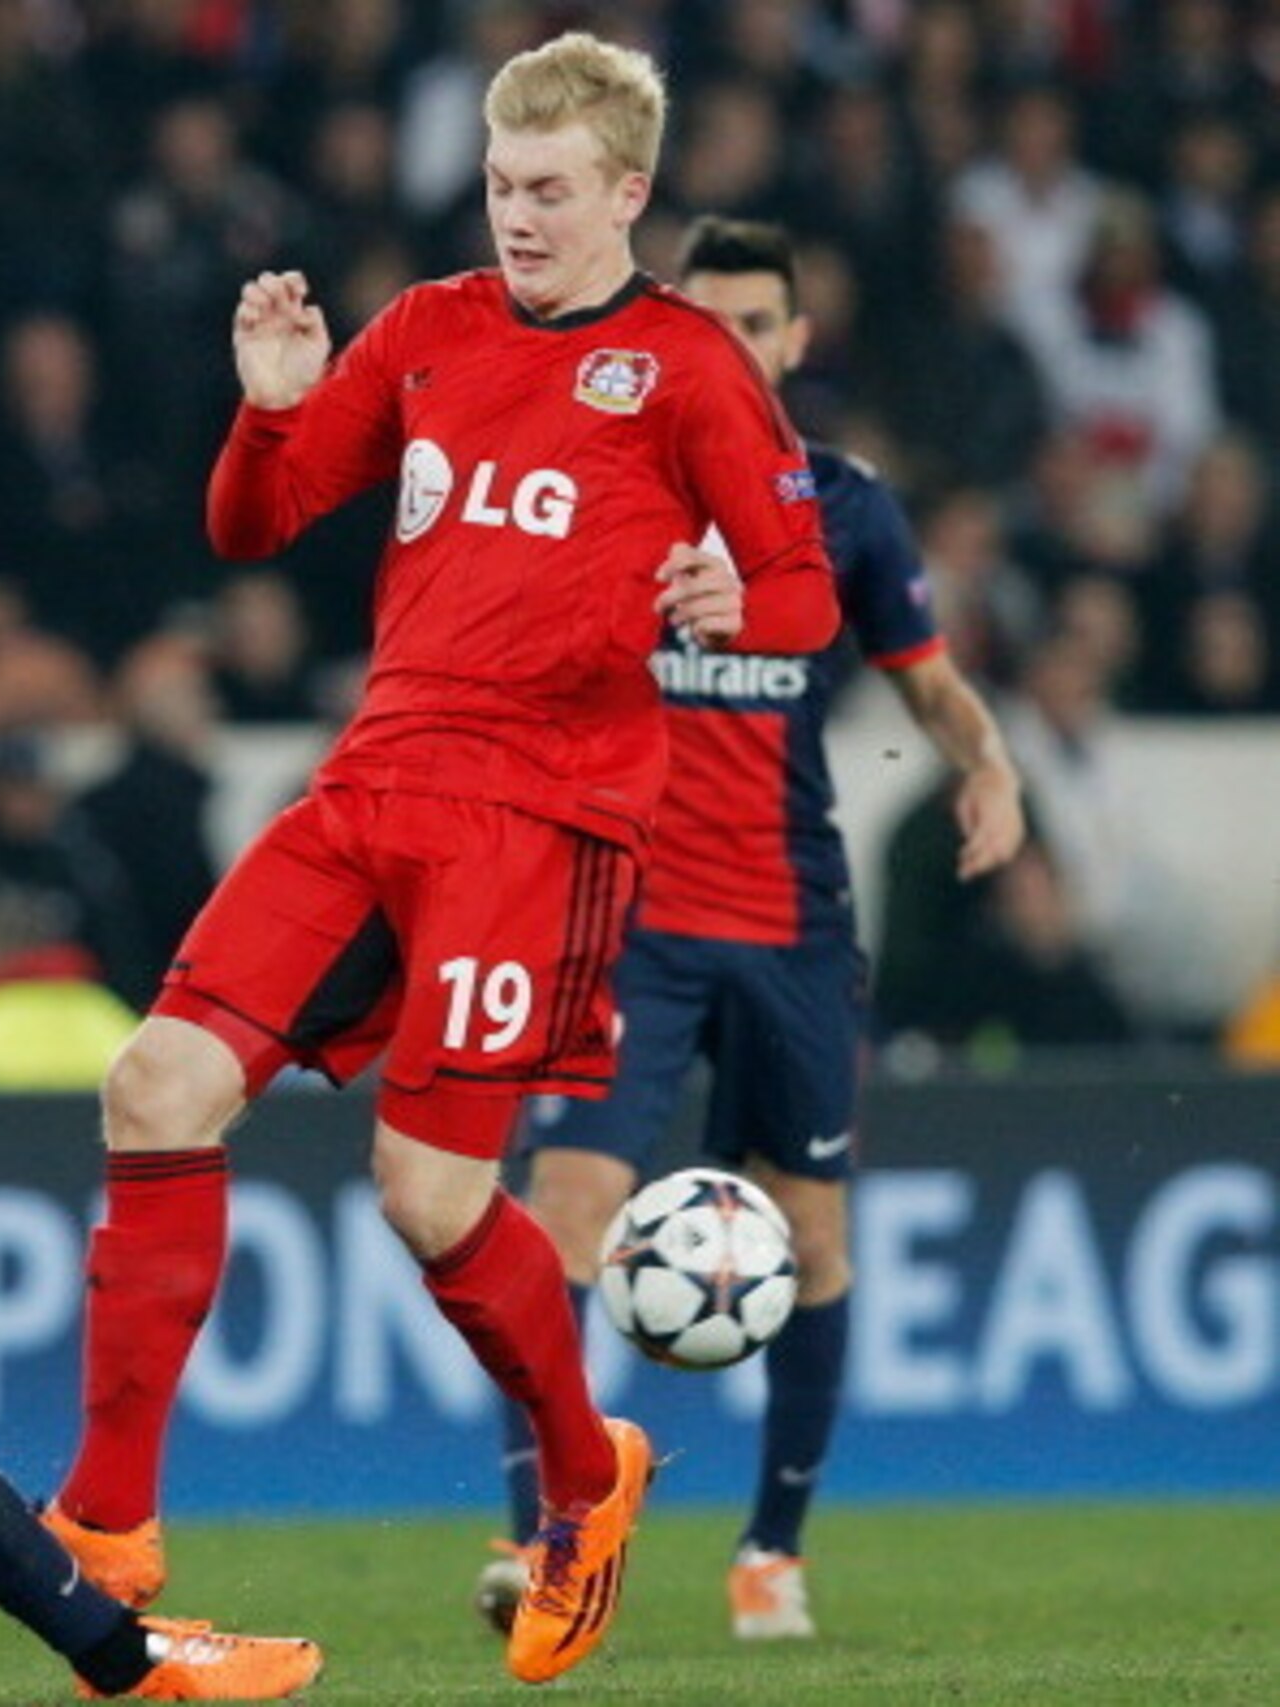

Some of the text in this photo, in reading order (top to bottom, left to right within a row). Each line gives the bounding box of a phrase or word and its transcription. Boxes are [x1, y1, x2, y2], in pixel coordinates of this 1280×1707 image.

[460, 460, 580, 540] LG
[646, 641, 811, 699] mirates
[438, 956, 532, 1053] 19
[720, 1163, 1280, 1425] EAG
